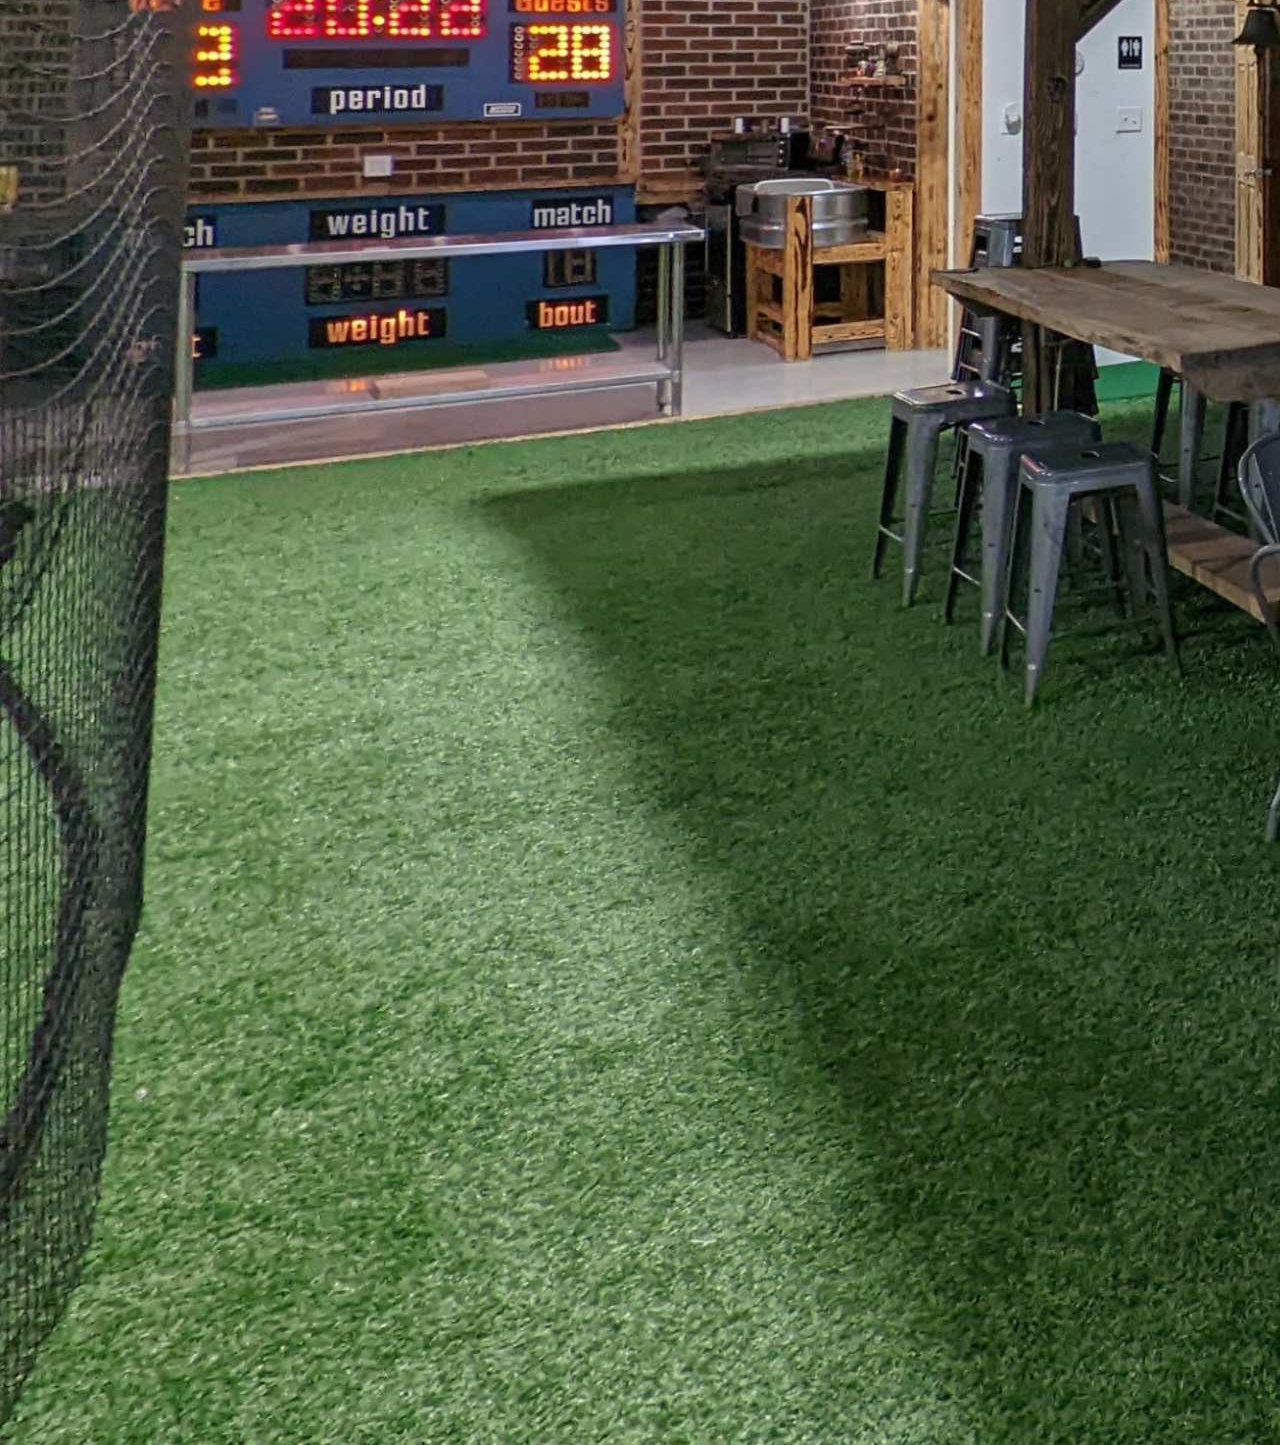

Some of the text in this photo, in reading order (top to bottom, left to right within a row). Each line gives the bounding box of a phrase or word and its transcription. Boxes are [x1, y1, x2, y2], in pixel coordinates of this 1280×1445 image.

[529, 25, 610, 80] 28
[330, 84, 427, 115] period
[328, 206, 430, 239] weight
[533, 199, 611, 228] match
[327, 310, 430, 344] weight
[538, 300, 596, 329] bout
